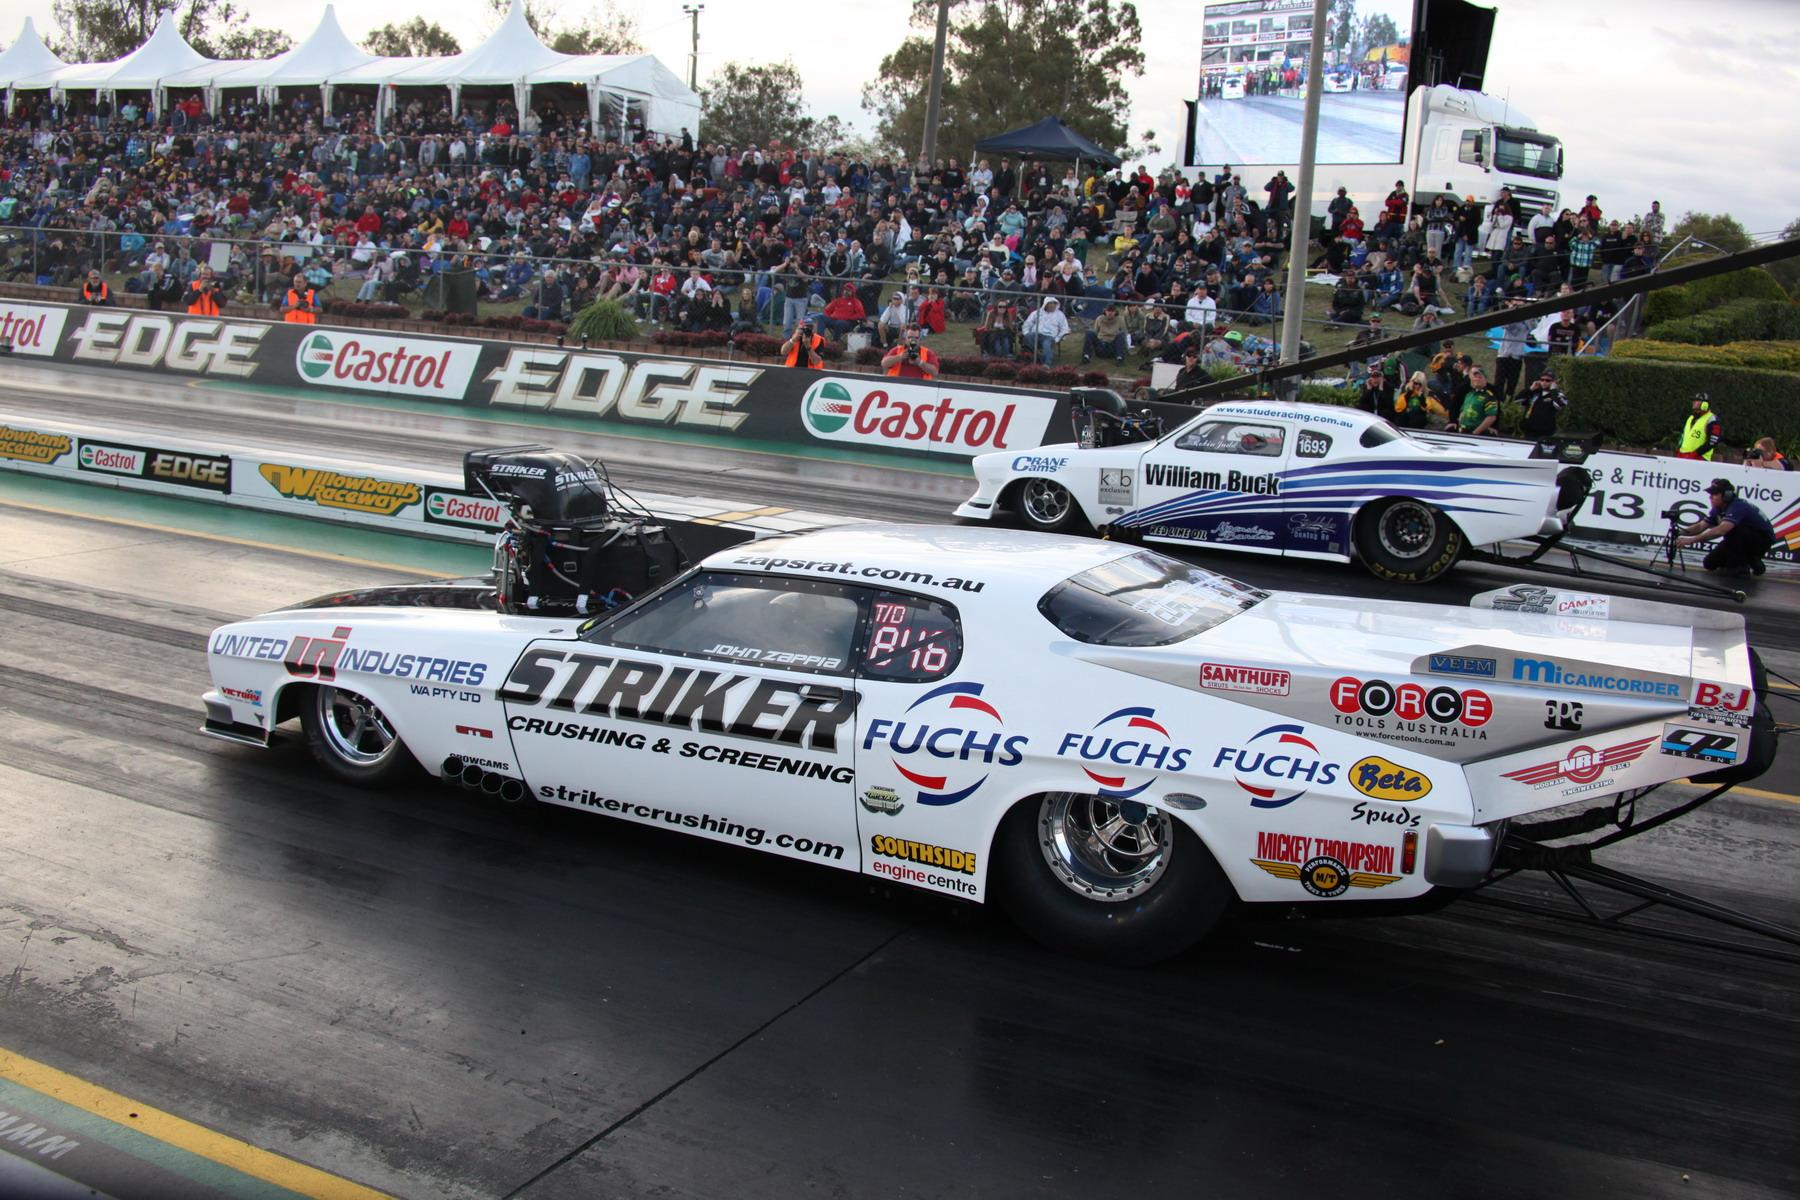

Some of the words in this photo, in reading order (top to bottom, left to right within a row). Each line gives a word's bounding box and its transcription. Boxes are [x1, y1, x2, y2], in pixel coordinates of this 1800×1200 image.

[69, 310, 272, 378] EDGE
[334, 340, 452, 390] Castrol
[483, 347, 766, 431] EDGE
[853, 389, 1017, 450] Castrol
[1216, 407, 1353, 428] www.studeracing.com.au
[95, 449, 136, 471] Castrol
[1299, 439, 1327, 454] 1693
[152, 453, 230, 484] EDGE
[491, 464, 547, 476] STRIKER
[1145, 463, 1222, 491] William
[1228, 470, 1280, 497] Buck
[1611, 467, 1624, 484] &
[1631, 469, 1701, 495] Fittings
[279, 466, 422, 504] Willowbank
[309, 486, 404, 511] Raceway
[446, 498, 501, 523] Castrol
[1588, 490, 1645, 520] 13
[1150, 525, 1168, 536] RED
[1169, 527, 1191, 538] LINE
[1192, 529, 1207, 541] OIL
[213, 633, 288, 661] UNITED
[339, 648, 488, 687] INDUSTRIES
[1203, 666, 1289, 687] SANTHUFF
[1432, 656, 1494, 673] VEEM
[411, 684, 430, 697] WA
[432, 687, 457, 700] PTY
[459, 690, 481, 703] LTD
[494, 647, 861, 753] STRIKER
[1335, 682, 1488, 721] FORCE
[1694, 682, 1750, 711] B&J
[863, 718, 1029, 767] FUCHS
[1335, 715, 1385, 729] TOOLS
[1396, 722, 1488, 741] AUSTRALIA
[1356, 730, 1456, 748] www.forcetools.com.au
[508, 715, 646, 750] CRUSHING
[653, 736, 672, 754] &
[679, 741, 855, 785] SCREENING
[1056, 732, 1192, 772] FUCHS
[1558, 751, 1606, 773] NRE
[1660, 747, 1737, 766] PISTONS
[1213, 747, 1341, 785] FUCHS
[1358, 763, 1422, 792] Beta
[1562, 779, 1615, 796] ENGINEERING
[539, 784, 845, 860] strikercrushing.com
[1350, 801, 1421, 827] Spuds
[871, 834, 977, 876] SOUTHSIDE
[1257, 831, 1313, 864] MICKEY
[1315, 837, 1395, 875] THOMPSON
[873, 861, 926, 882] engine
[927, 874, 977, 896] centre
[1316, 872, 1336, 883] M/T
